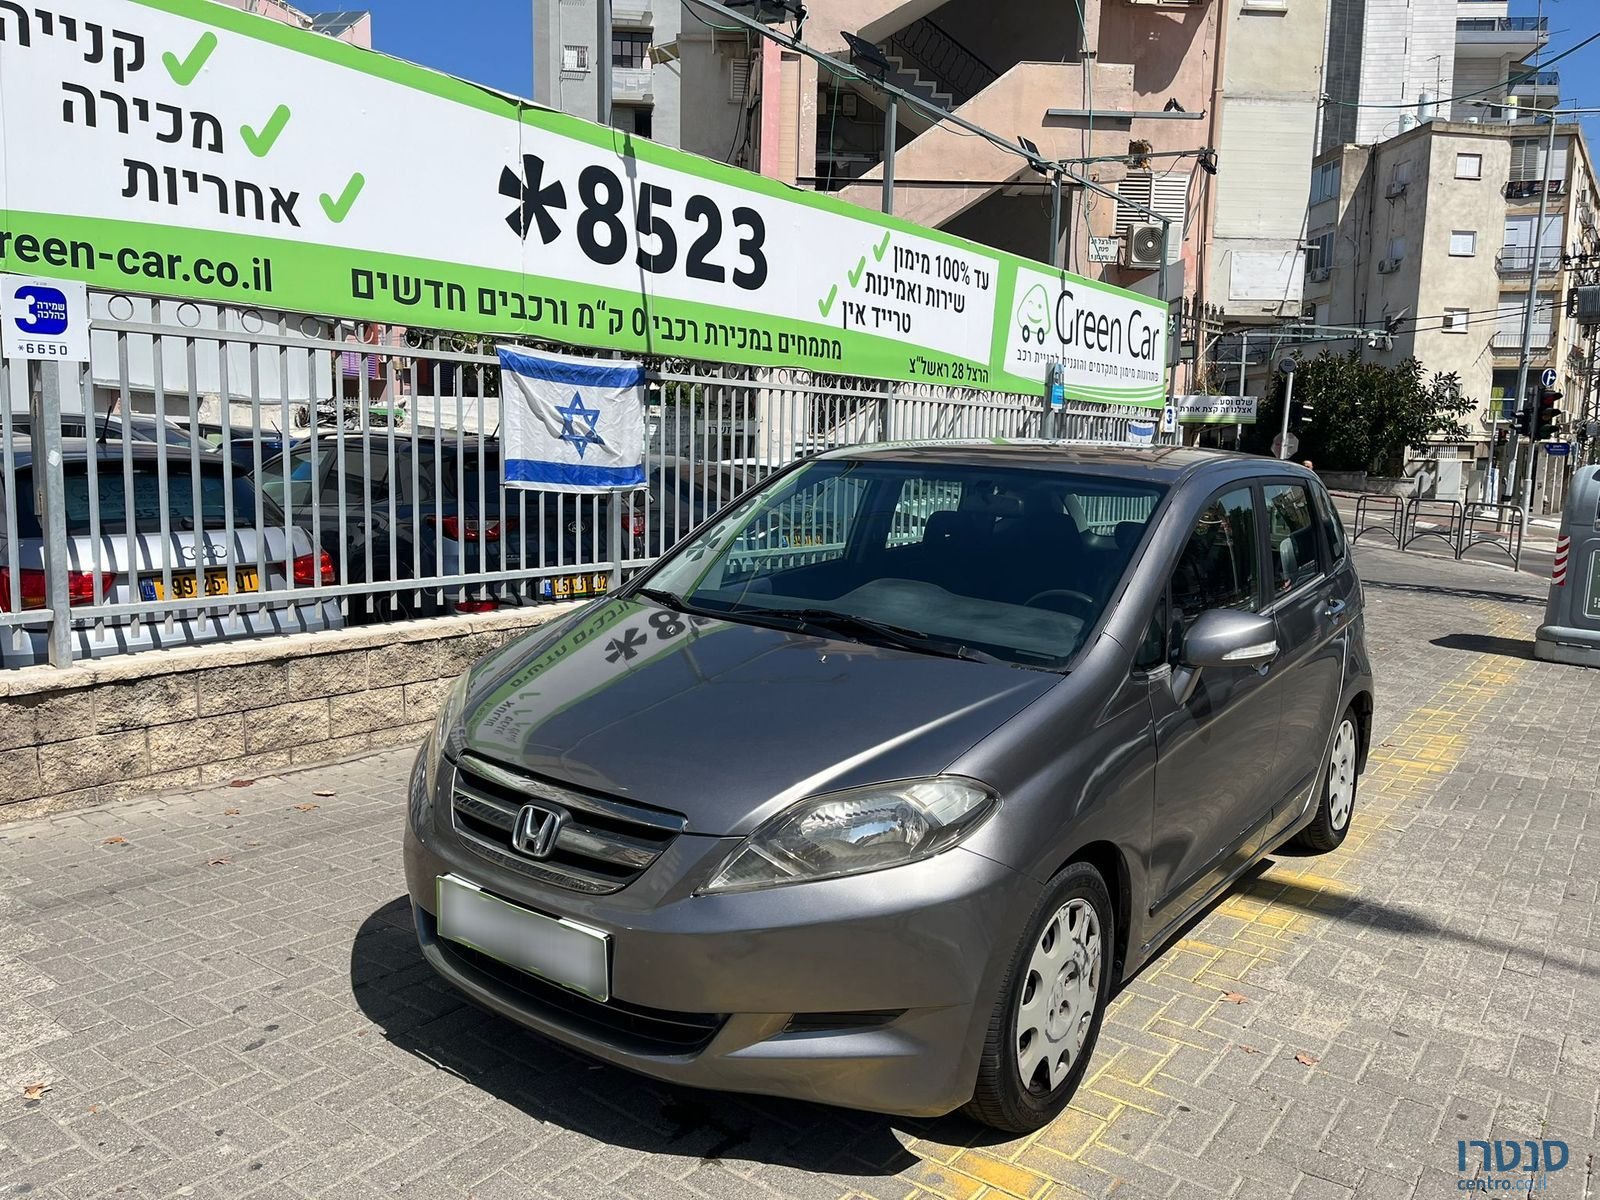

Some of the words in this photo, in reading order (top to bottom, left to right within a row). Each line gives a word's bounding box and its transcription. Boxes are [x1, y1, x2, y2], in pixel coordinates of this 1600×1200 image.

[0, 0, 145, 83] קנייה
[62, 81, 224, 154] מכירה
[122, 158, 301, 228] אחריות
[893, 245, 930, 275] מימון
[935, 255, 970, 285] 100%
[351, 268, 466, 312] חדשים
[865, 272, 921, 304] ואמינות
[974, 269, 989, 291] עד
[36, 301, 65, 311] שמירה
[37, 310, 66, 320] כהלכה
[477, 287, 568, 326] ורכבים
[842, 300, 866, 330] אין
[926, 288, 965, 313] שירות
[631, 307, 646, 337] 0
[653, 315, 698, 344] רכבי
[871, 307, 911, 334] טרייד
[1056, 290, 1123, 354] Green
[1128, 309, 1160, 361] Car
[704, 322, 773, 352] במכירת
[778, 332, 842, 360] מתמחים
[1017, 348, 1031, 361] רכב
[1088, 361, 1118, 377] מתקדמים
[951, 362, 964, 379] 28
[966, 363, 989, 384] הרצל
[1120, 366, 1135, 380] מימון
[1201, 406, 1218, 414] קצת
